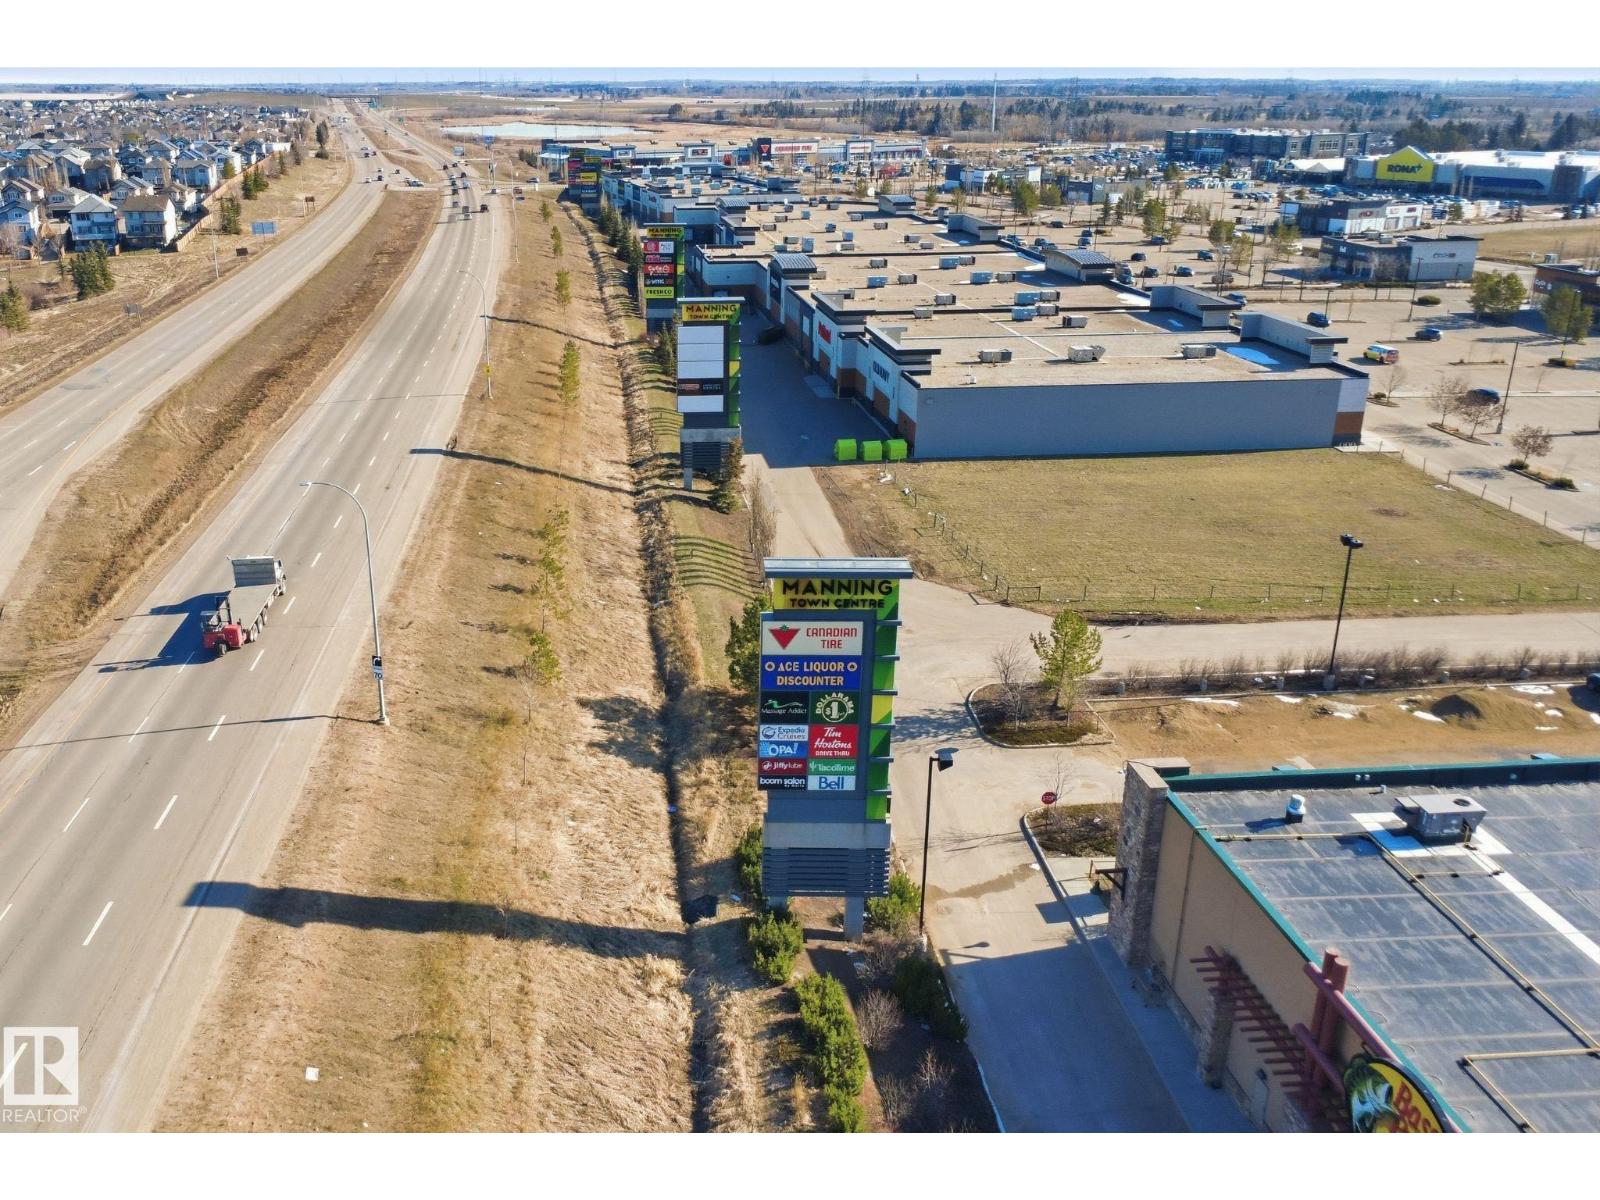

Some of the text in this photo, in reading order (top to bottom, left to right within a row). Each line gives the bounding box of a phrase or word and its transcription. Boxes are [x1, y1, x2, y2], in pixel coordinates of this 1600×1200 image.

[686, 304, 737, 313] MANNING
[783, 580, 893, 596] MANNING
[790, 598, 886, 609] TOWN CENTRE
[806, 627, 858, 638] CANADIAN
[820, 640, 843, 649] TIRE
[778, 662, 845, 673] ACE LIQUOR
[776, 676, 844, 686] DISCOUNTER
[815, 692, 854, 714] DOLLARAMA
[824, 727, 842, 737] Tim
[769, 742, 799, 756] OPA!
[814, 738, 852, 749] Hortons
[760, 777, 806, 785] boom salon
[819, 776, 844, 790] Bell
